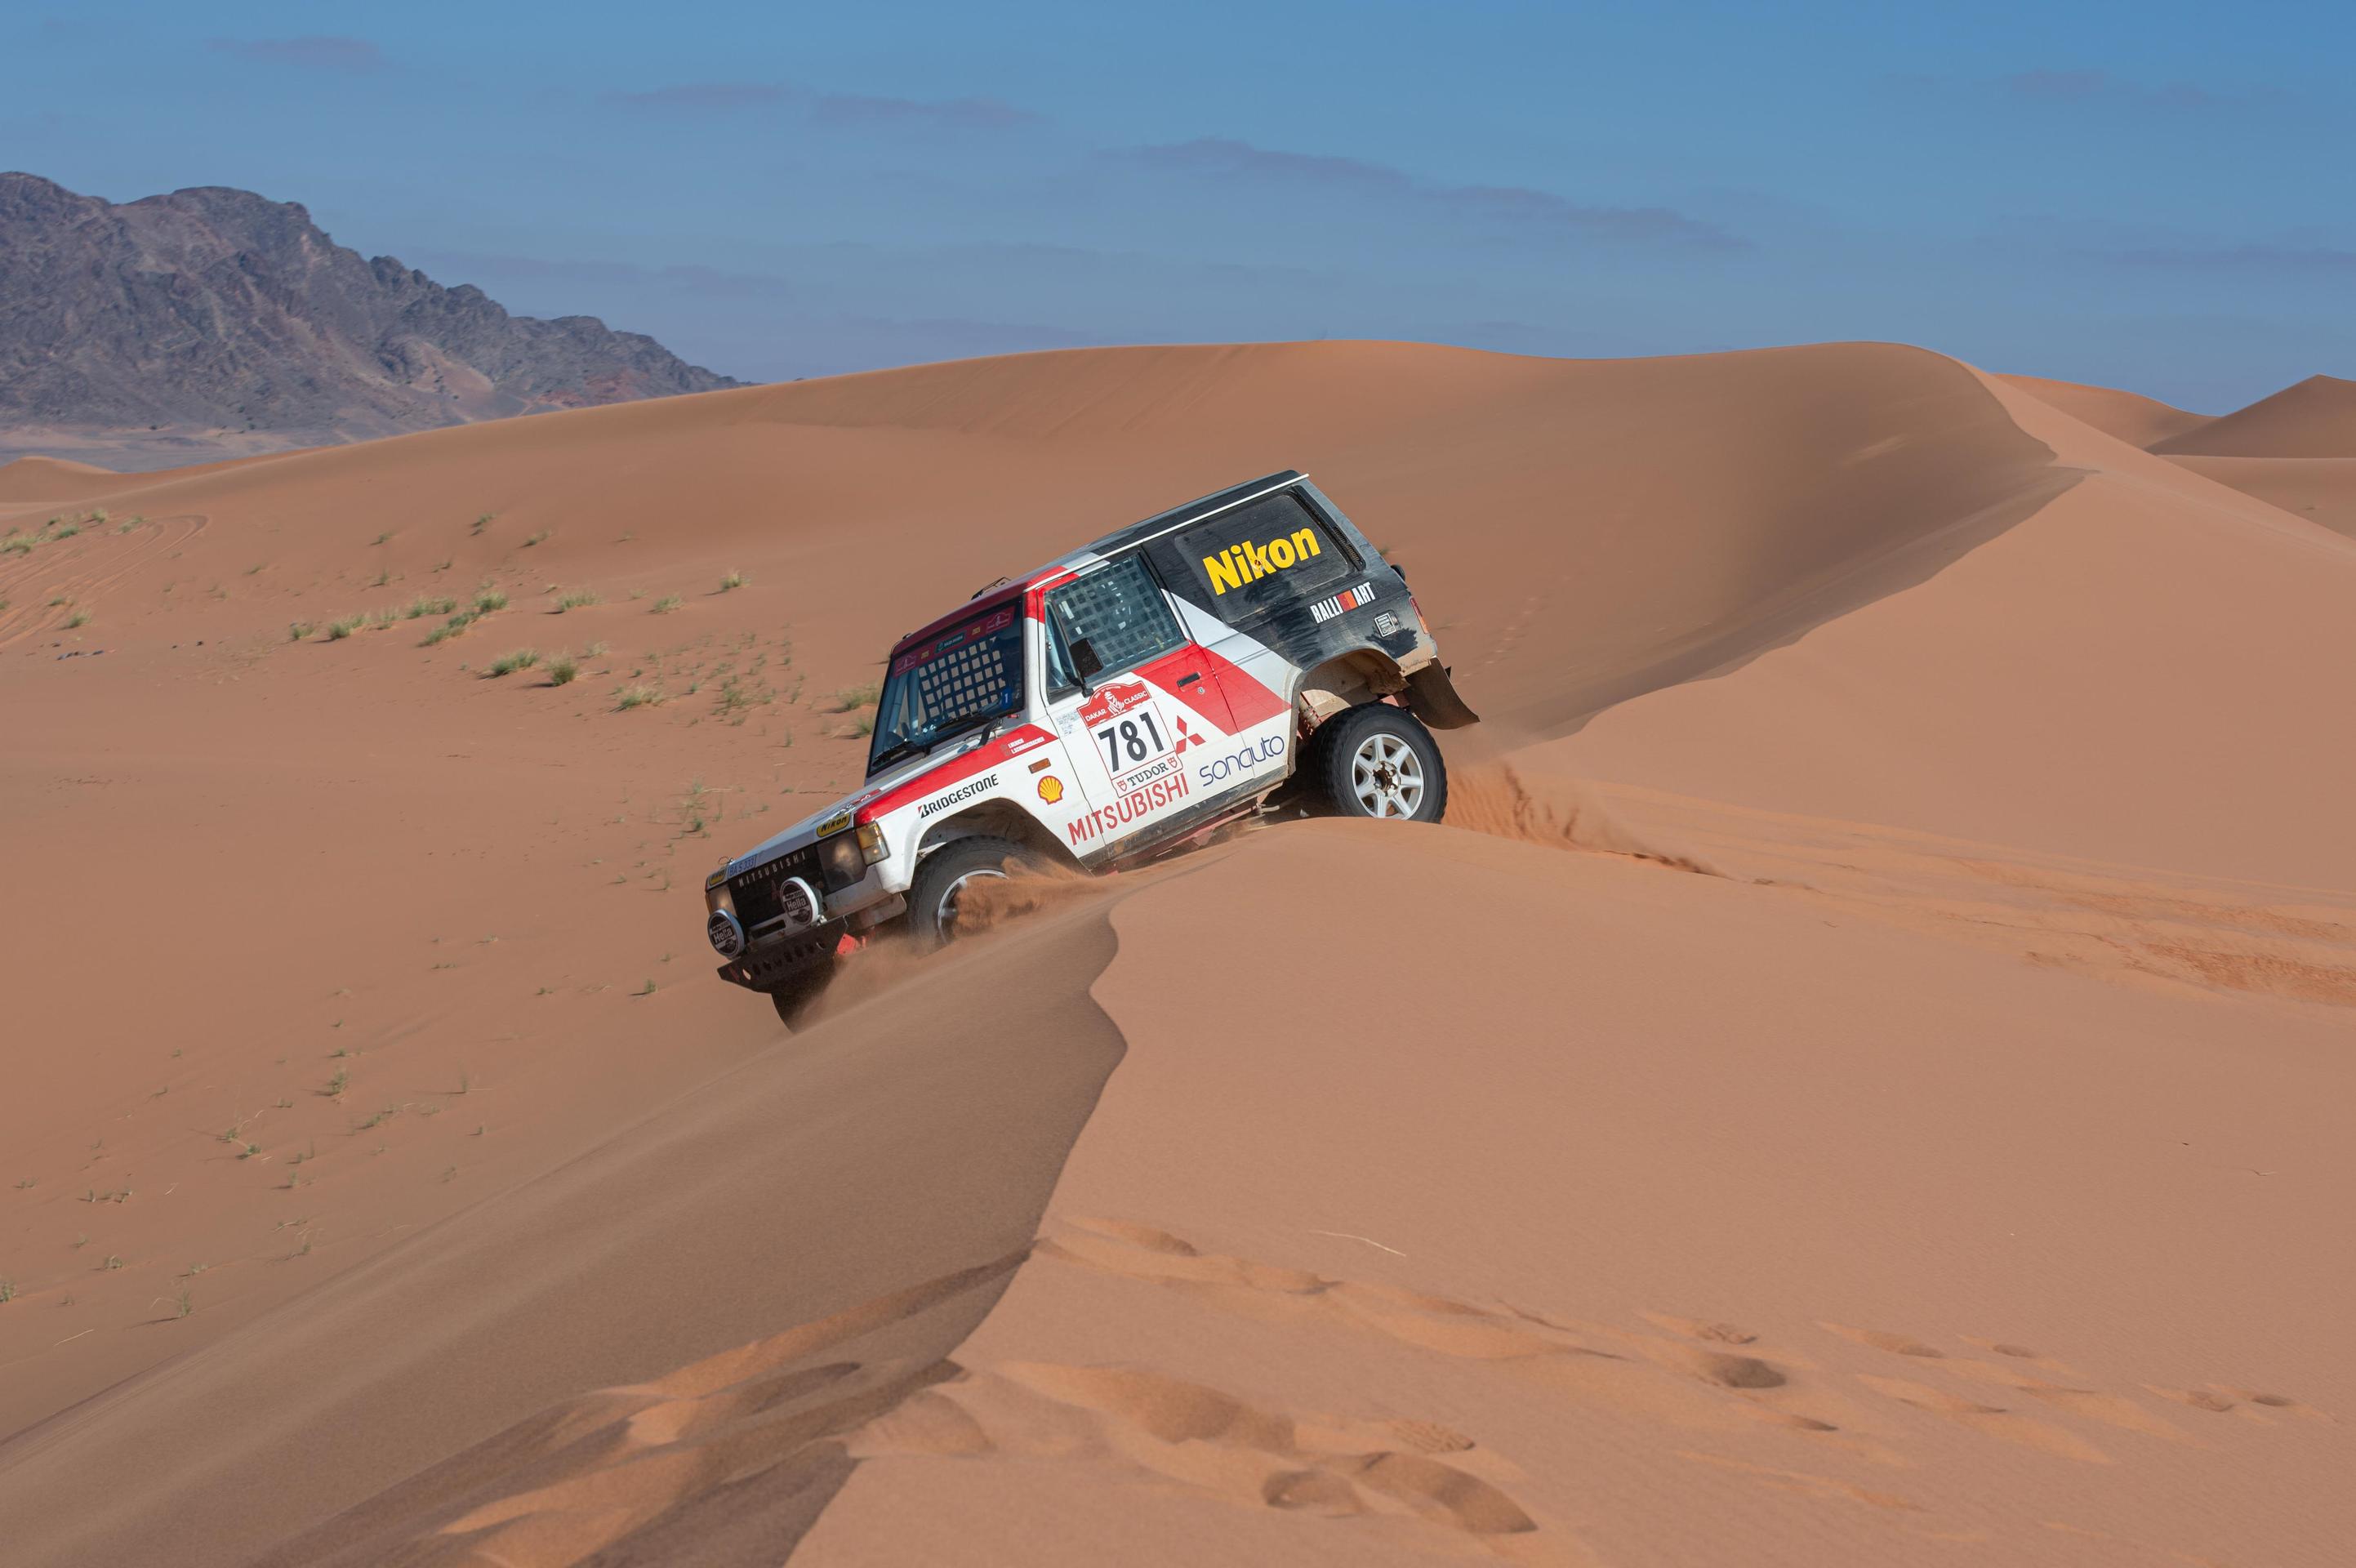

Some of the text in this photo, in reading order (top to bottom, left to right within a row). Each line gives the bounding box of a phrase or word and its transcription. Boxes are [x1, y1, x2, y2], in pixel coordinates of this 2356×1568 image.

[1203, 528, 1321, 596] Nikon
[1085, 708, 1107, 722] DAKAR
[1124, 690, 1147, 705] CLASSIC
[1098, 711, 1165, 773] 781
[1200, 735, 1285, 787] sonauto
[1127, 762, 1169, 786] TUDOR
[918, 773, 1000, 819] BRIDGESTONE
[1067, 773, 1190, 846] MITSUBISHI
[739, 851, 806, 889] MITSUBISHI
[786, 897, 807, 912] Hella
[713, 928, 733, 944] Hella
